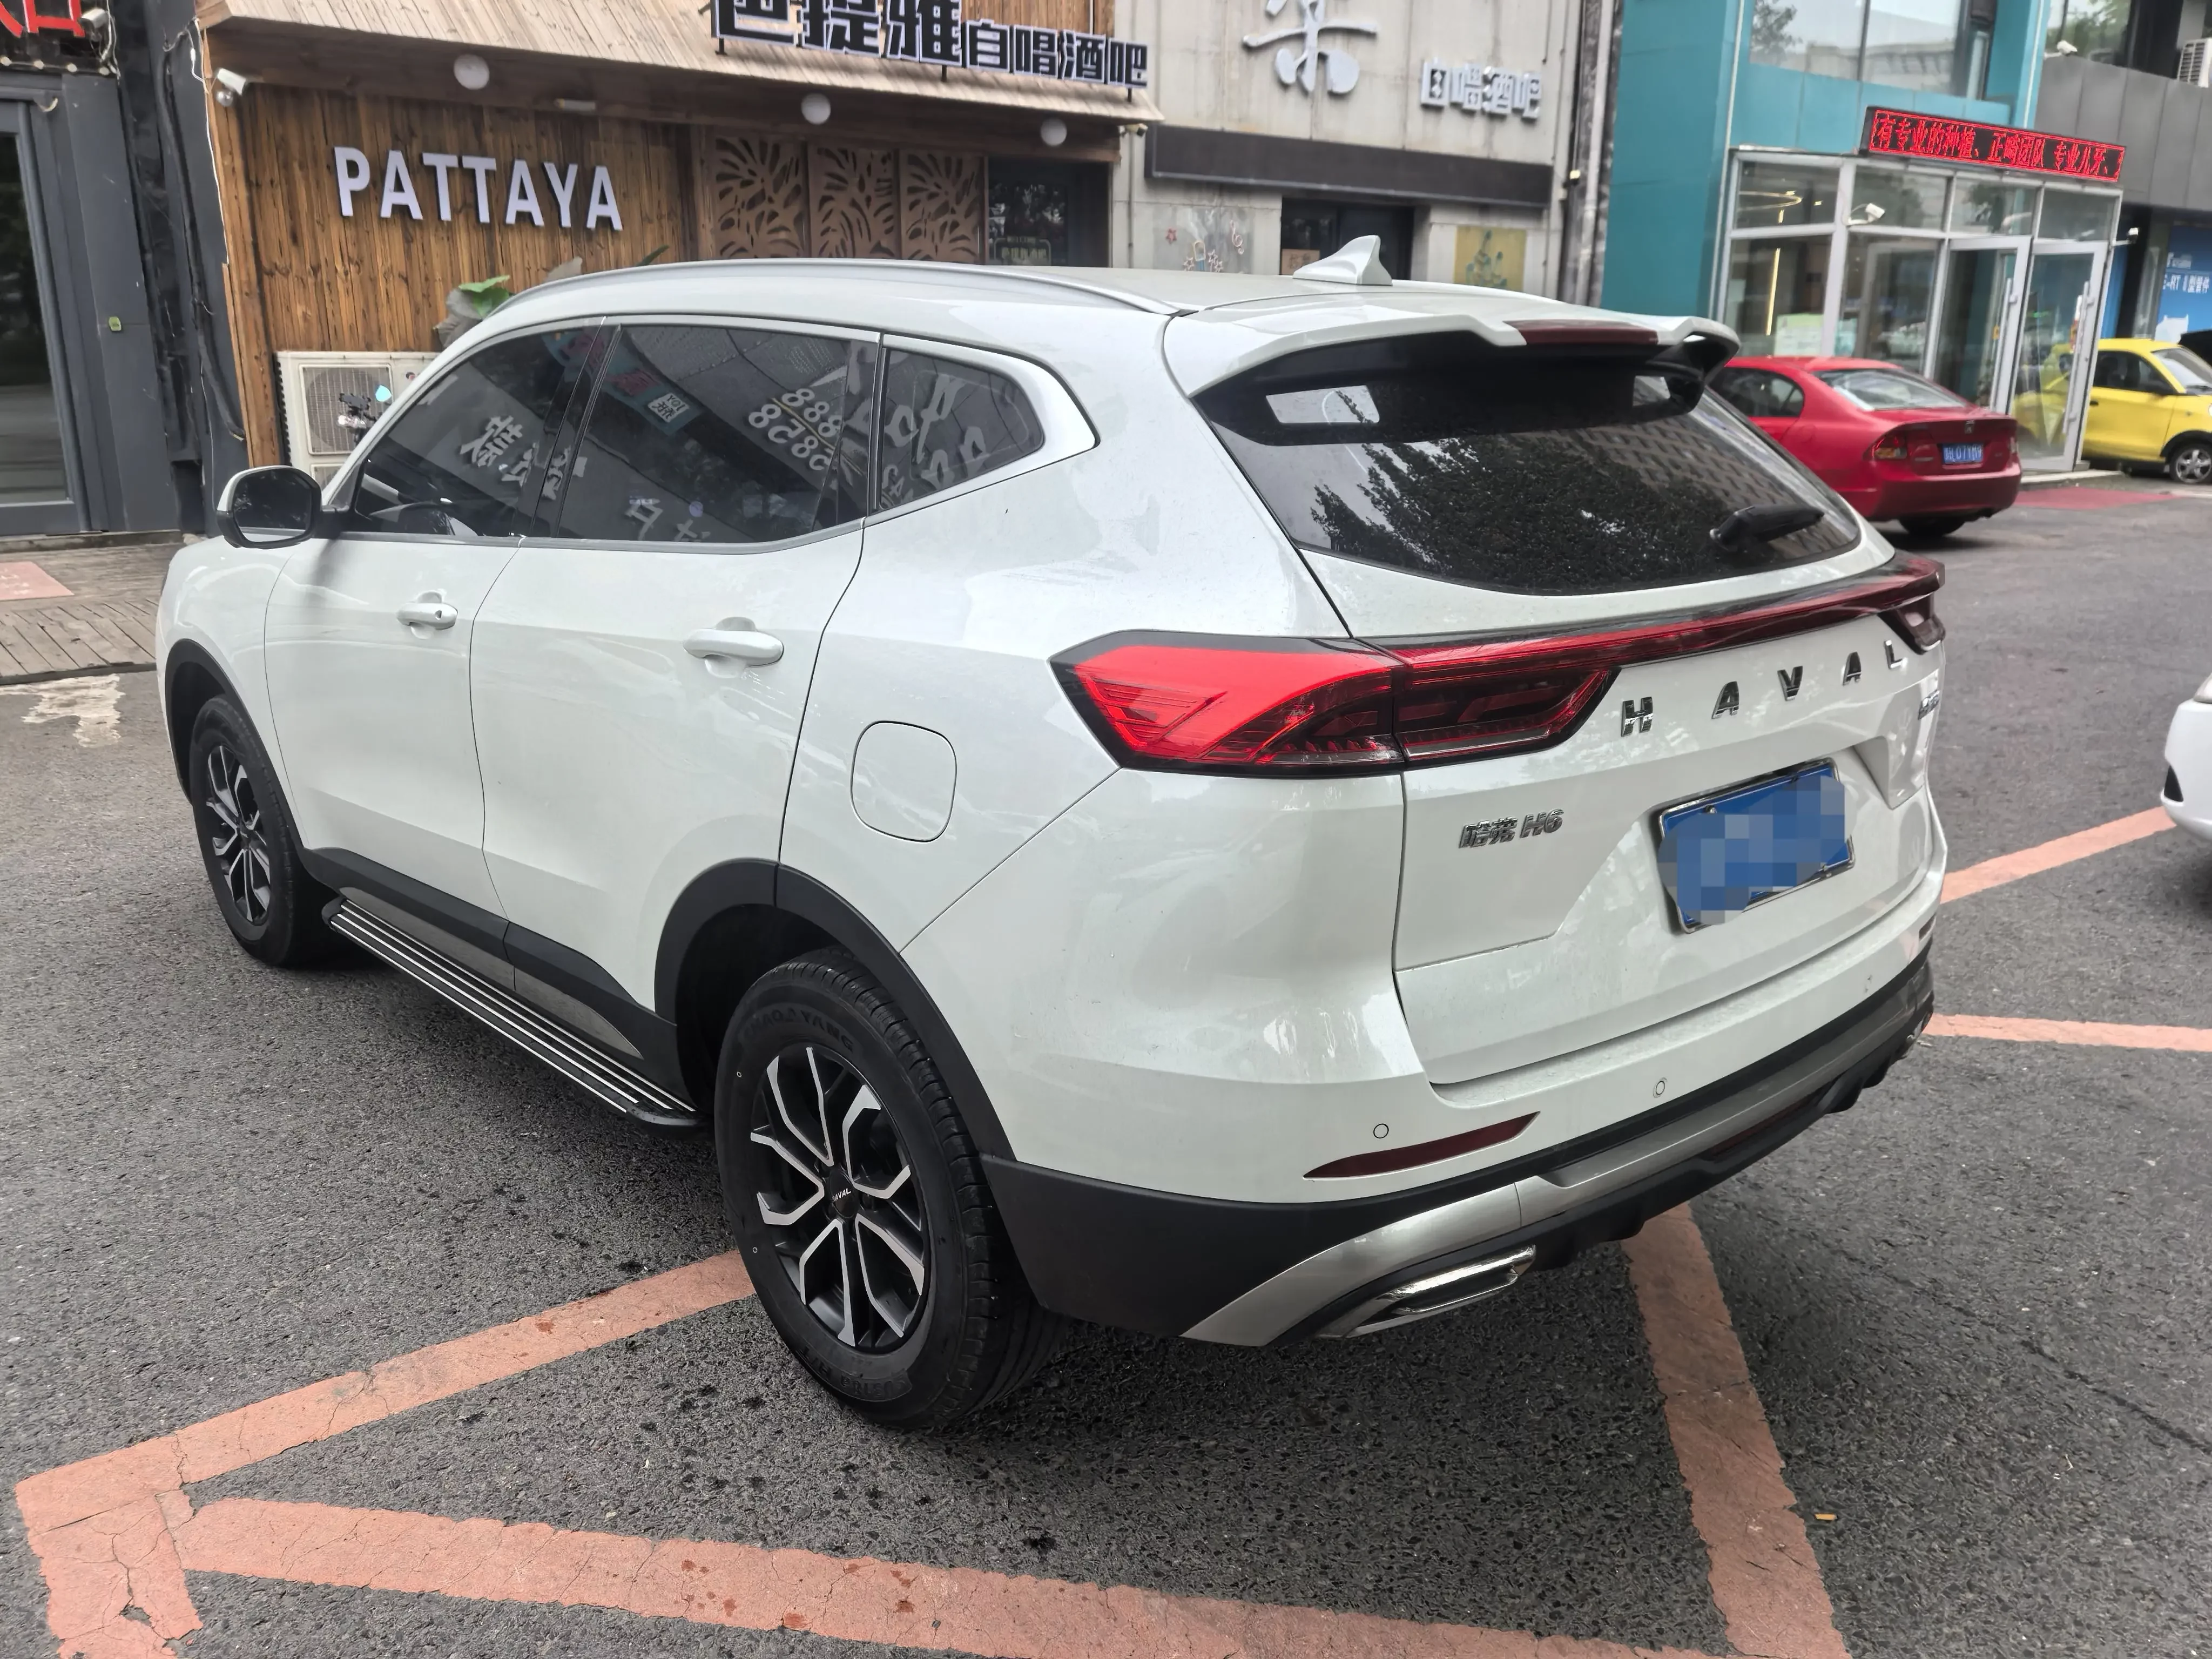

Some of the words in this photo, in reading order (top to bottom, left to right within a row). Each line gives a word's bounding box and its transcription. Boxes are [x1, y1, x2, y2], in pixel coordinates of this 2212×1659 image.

[966, 18, 1148, 88] 自唱酒吧
[334, 146, 623, 231] PATTAYA
[1621, 639, 1907, 737] HAVAL
[1459, 817, 1518, 848] 哈弗
[1519, 808, 1564, 838] H6
[832, 1188, 851, 1202] HAVAL
